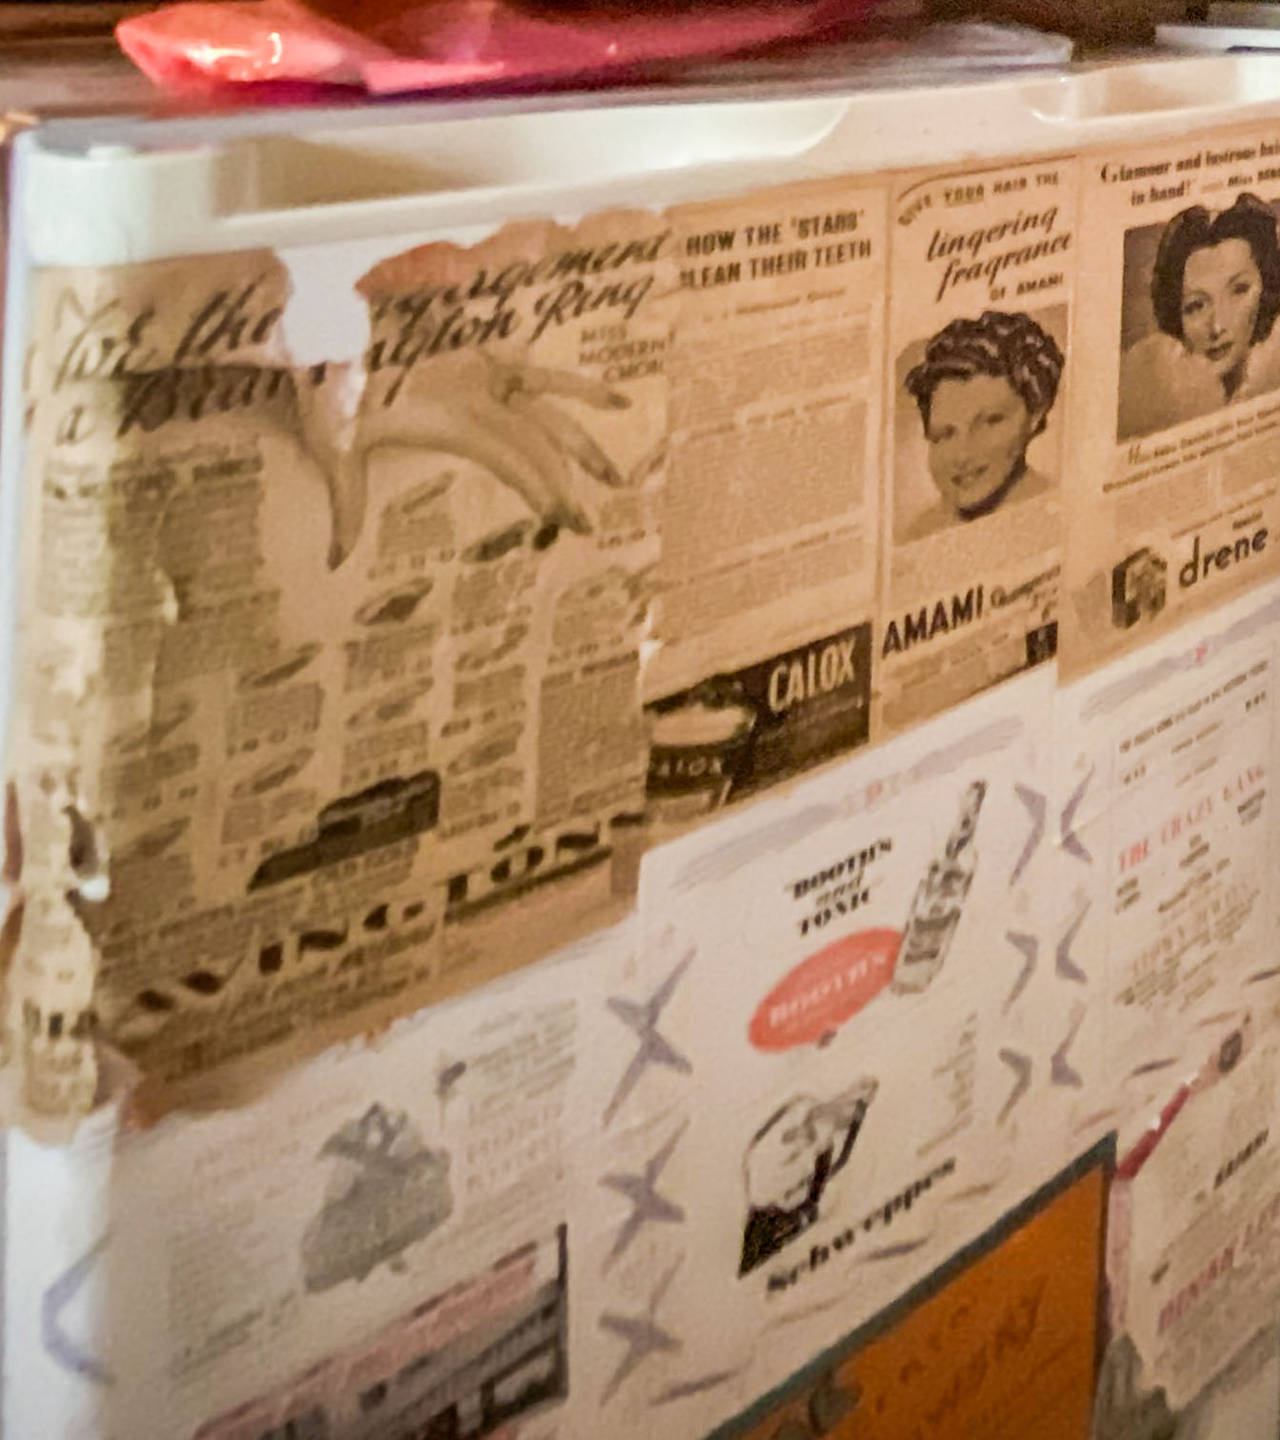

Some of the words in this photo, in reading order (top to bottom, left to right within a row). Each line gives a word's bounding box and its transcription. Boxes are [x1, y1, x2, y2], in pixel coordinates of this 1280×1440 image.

[943, 182, 985, 204] YOUR
[992, 167, 1028, 194] HAIR
[1036, 171, 1058, 188] THE
[685, 229, 736, 257] HOW
[745, 223, 781, 248] THE
[750, 249, 807, 281] THEIR
[814, 237, 871, 268] TEETH
[926, 205, 1059, 263] lingering
[935, 232, 1073, 303] fragrance
[1015, 271, 1064, 297] AMAMI
[1179, 527, 1269, 588] drene
[882, 583, 984, 660] AMAMI
[768, 637, 857, 715] CALOX
